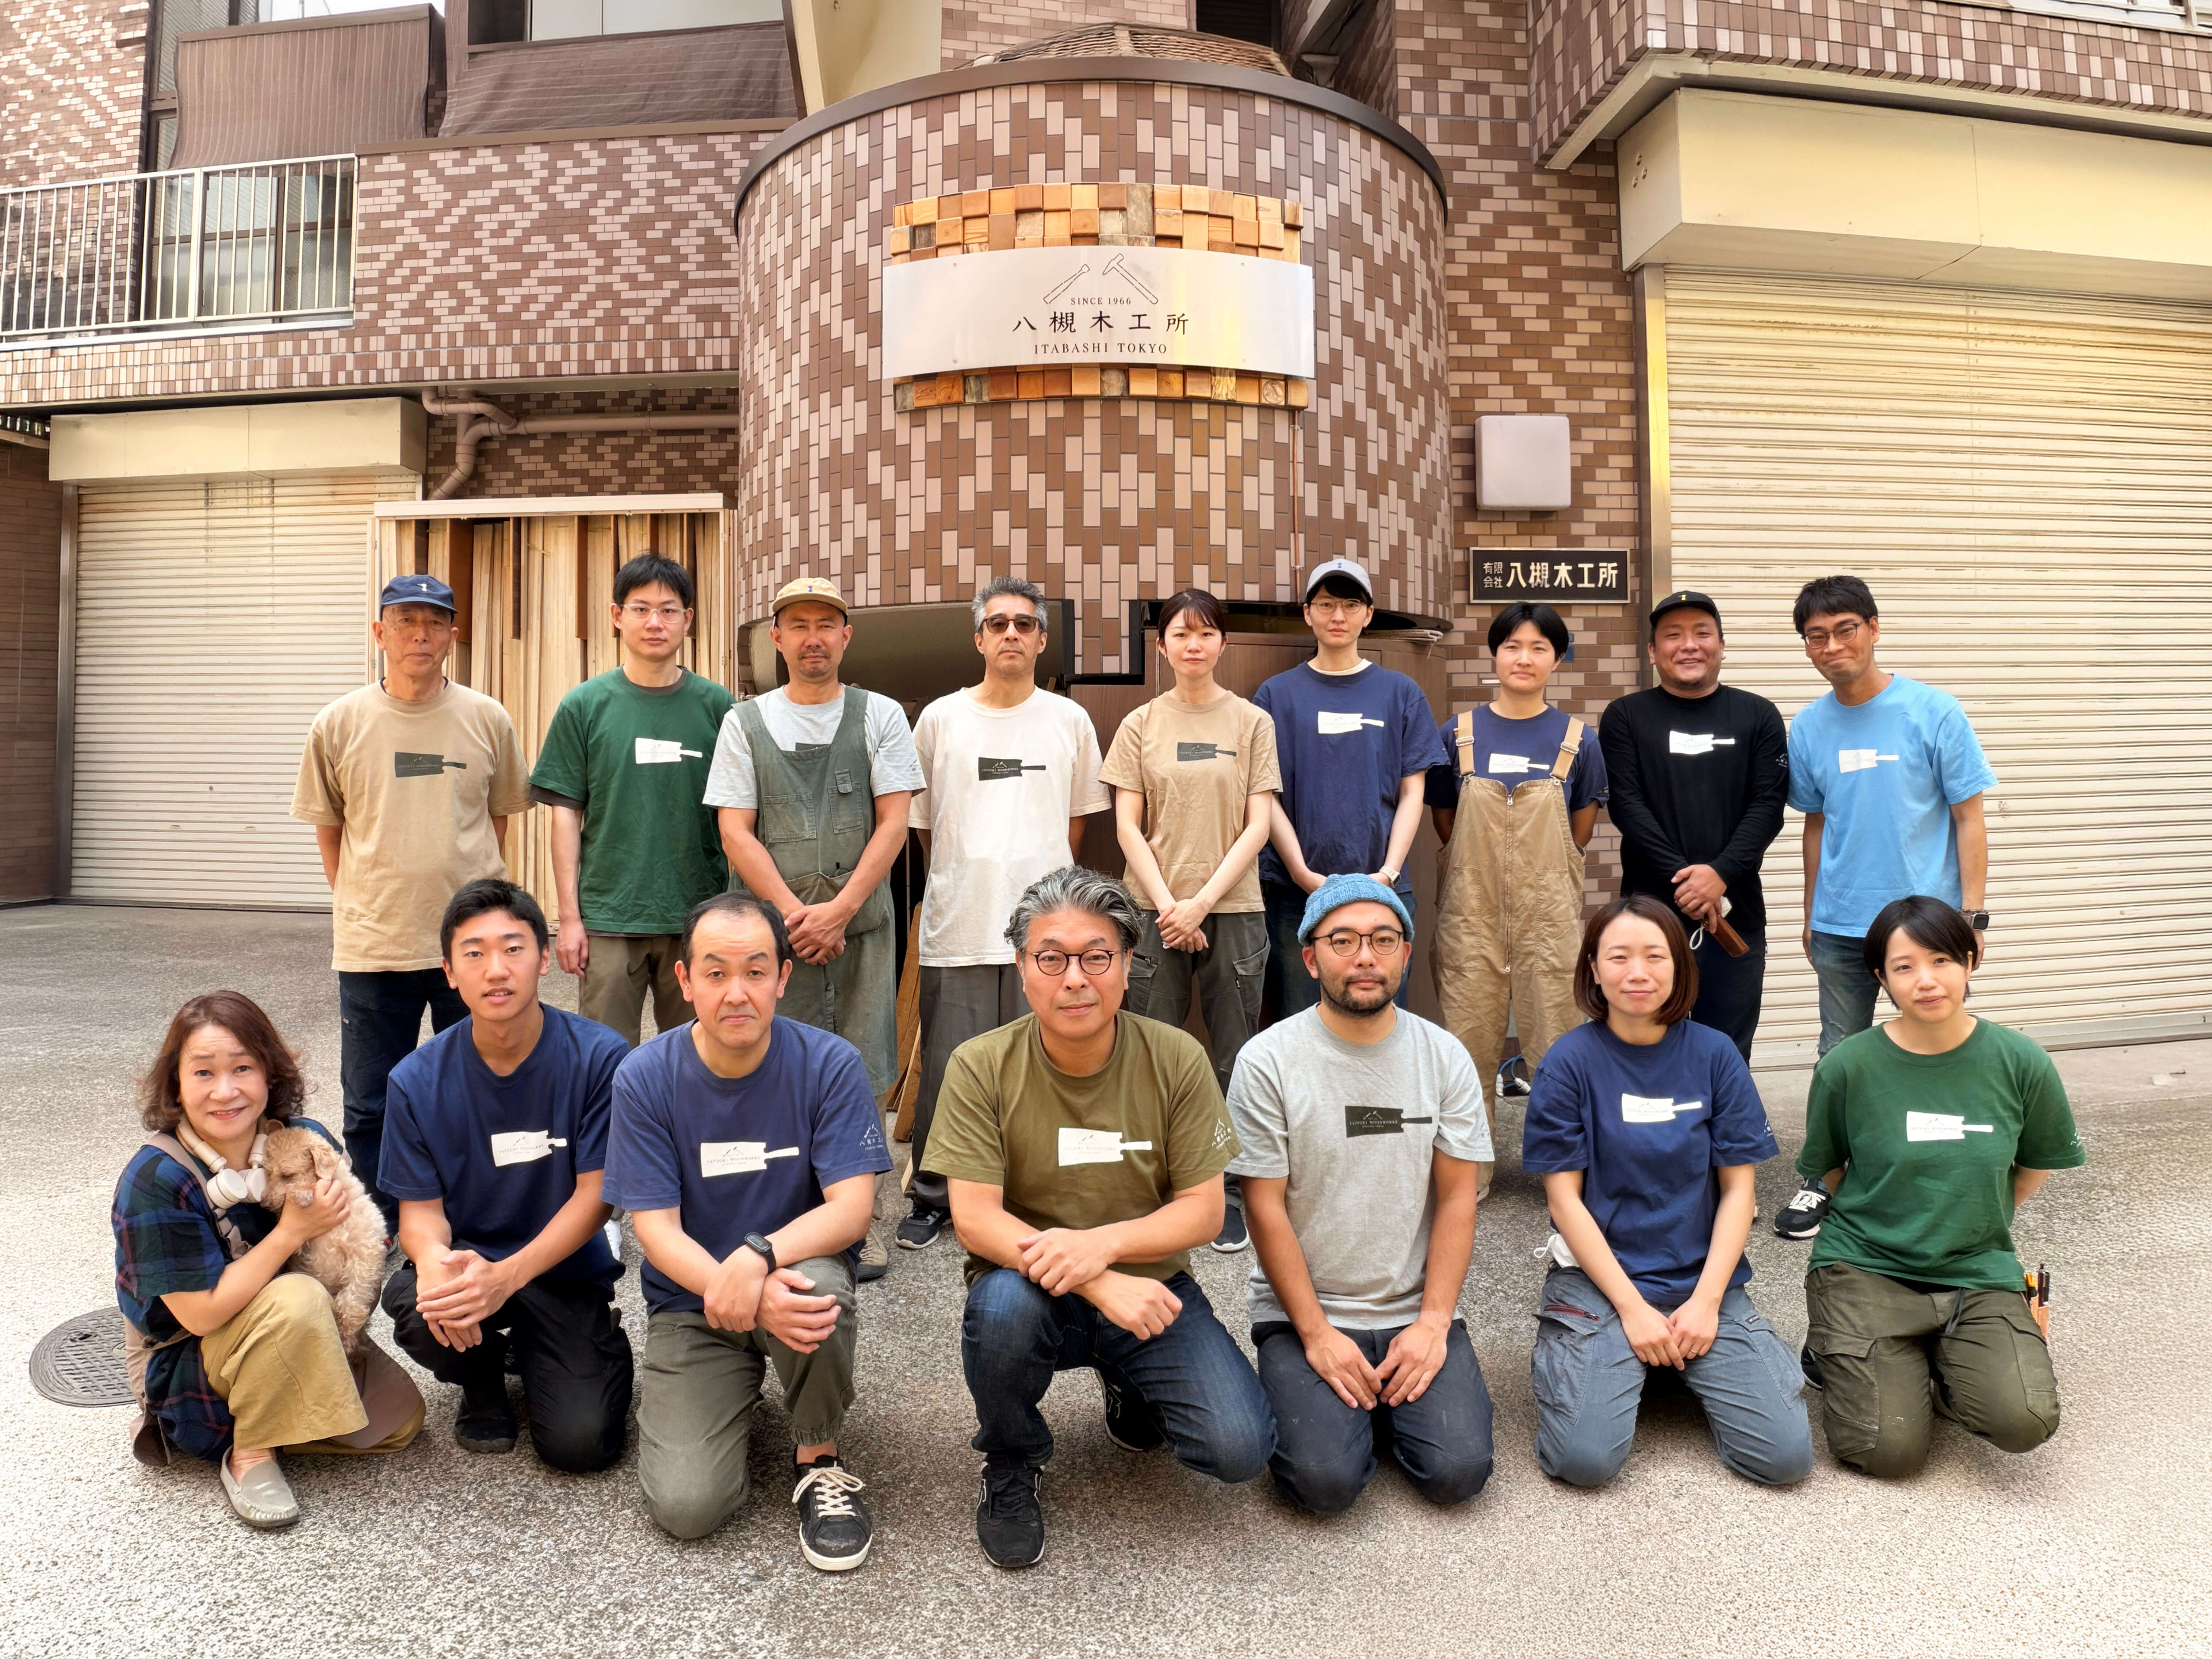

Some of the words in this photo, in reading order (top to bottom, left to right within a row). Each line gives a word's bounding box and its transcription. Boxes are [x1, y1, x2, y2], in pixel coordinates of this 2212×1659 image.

[1071, 297, 1103, 305] SINCE
[1108, 297, 1132, 305] 1966
[1012, 310, 1189, 336] 八槻木工所
[1034, 343, 1108, 355] ITABASHI
[1117, 343, 1167, 354] TOKYO
[1483, 562, 1503, 574] 有限
[1506, 562, 1618, 589] 八槻木工所
[1483, 576, 1503, 589] 会社
